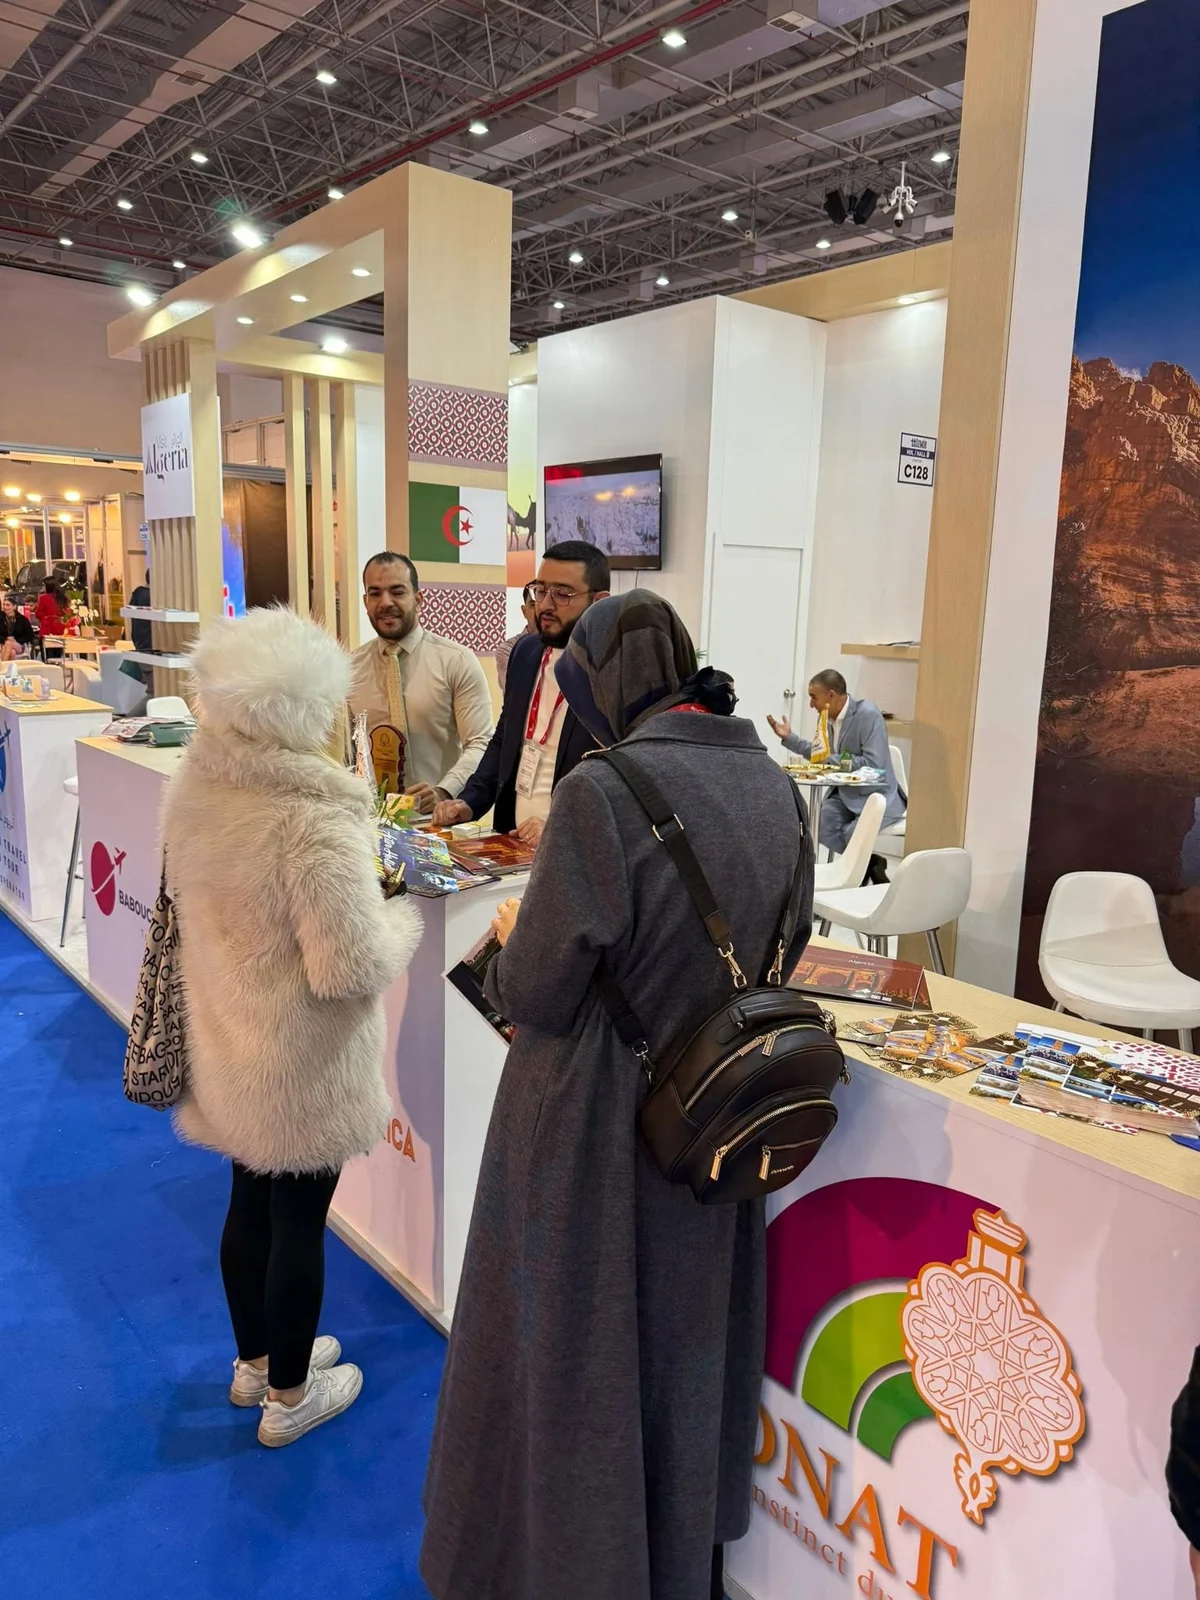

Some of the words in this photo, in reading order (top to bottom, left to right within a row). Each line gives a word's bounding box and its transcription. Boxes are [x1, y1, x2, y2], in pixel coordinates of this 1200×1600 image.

[145, 443, 189, 484] Algeria
[904, 464, 929, 480] C128
[3, 838, 27, 865] TRAVEL
[3, 855, 19, 876] TOUR
[119, 889, 153, 923] BABOUC
[753, 1484, 849, 1576] nstinct
